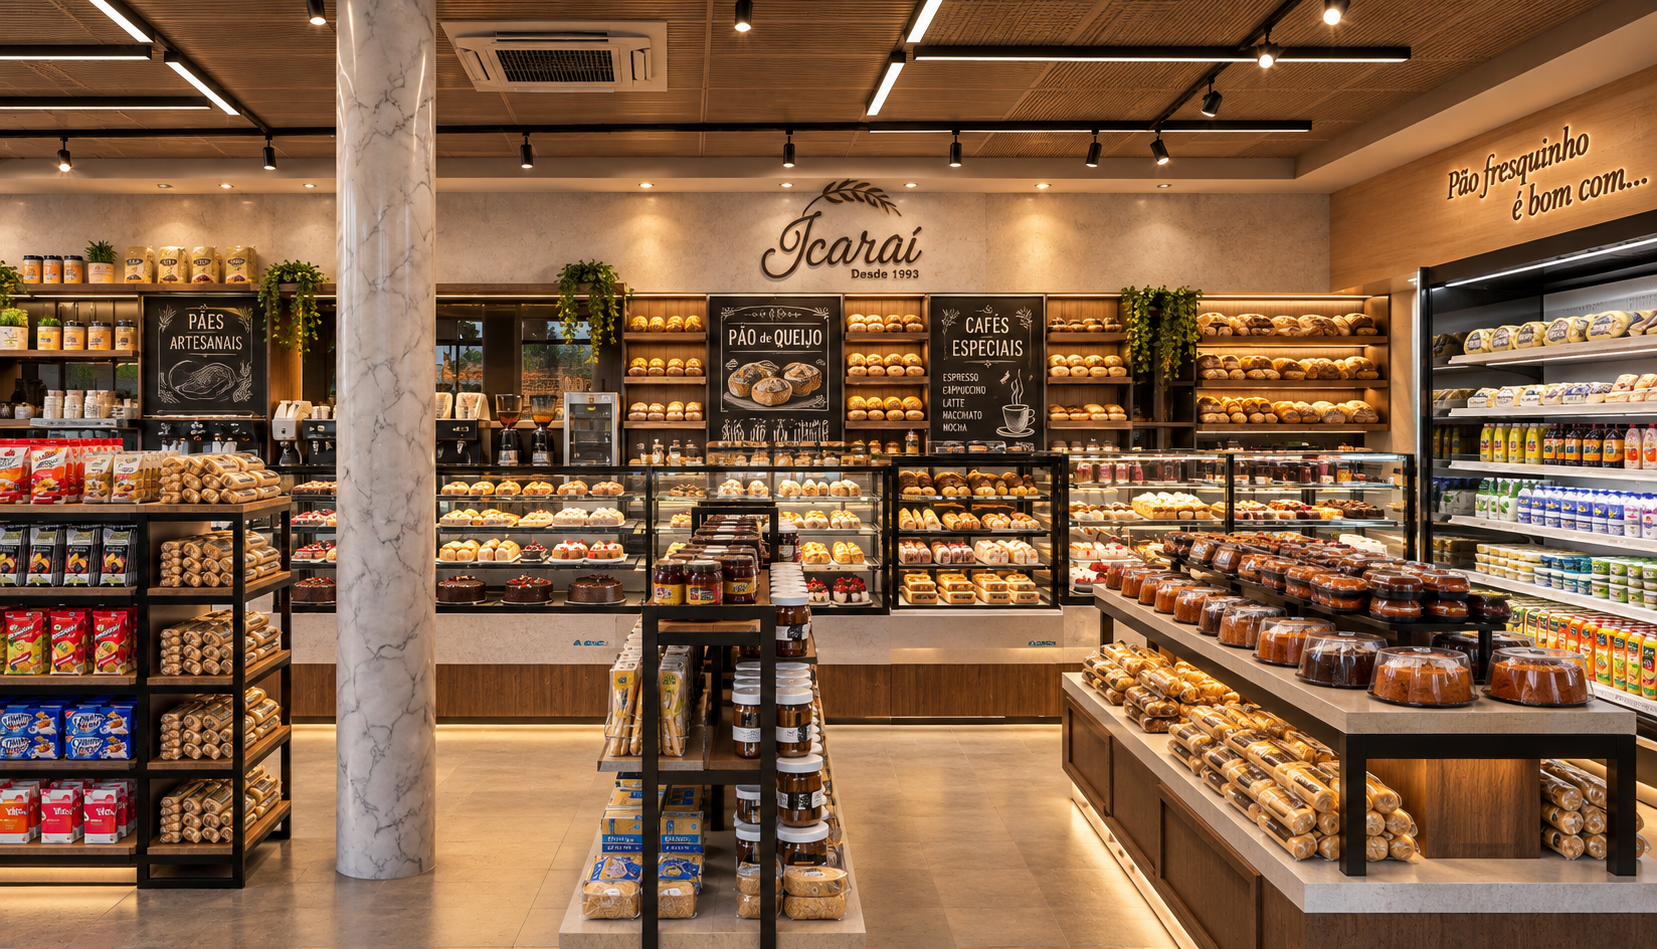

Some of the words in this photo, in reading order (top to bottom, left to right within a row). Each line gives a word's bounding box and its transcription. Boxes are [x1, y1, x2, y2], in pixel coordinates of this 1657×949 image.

[1447, 168, 1479, 200] Pão
[1479, 126, 1589, 199] fresquinho
[1512, 190, 1523, 221] é
[1528, 183, 1573, 216] bom
[1578, 168, 1648, 202] com...
[761, 210, 923, 279] Icaraí
[851, 268, 888, 279] Desde
[892, 269, 919, 279] 1993
[188, 310, 224, 330] PÃES
[965, 313, 1009, 334] CAFÉS
[169, 335, 243, 350] ARTESANAIS
[728, 325, 756, 346] PÃO
[759, 332, 773, 344] de
[774, 328, 823, 348] QUEIJO
[952, 339, 1024, 357] ESPECIAIS
[942, 373, 979, 382] ESPRESSO
[942, 398, 965, 408] LATTE
